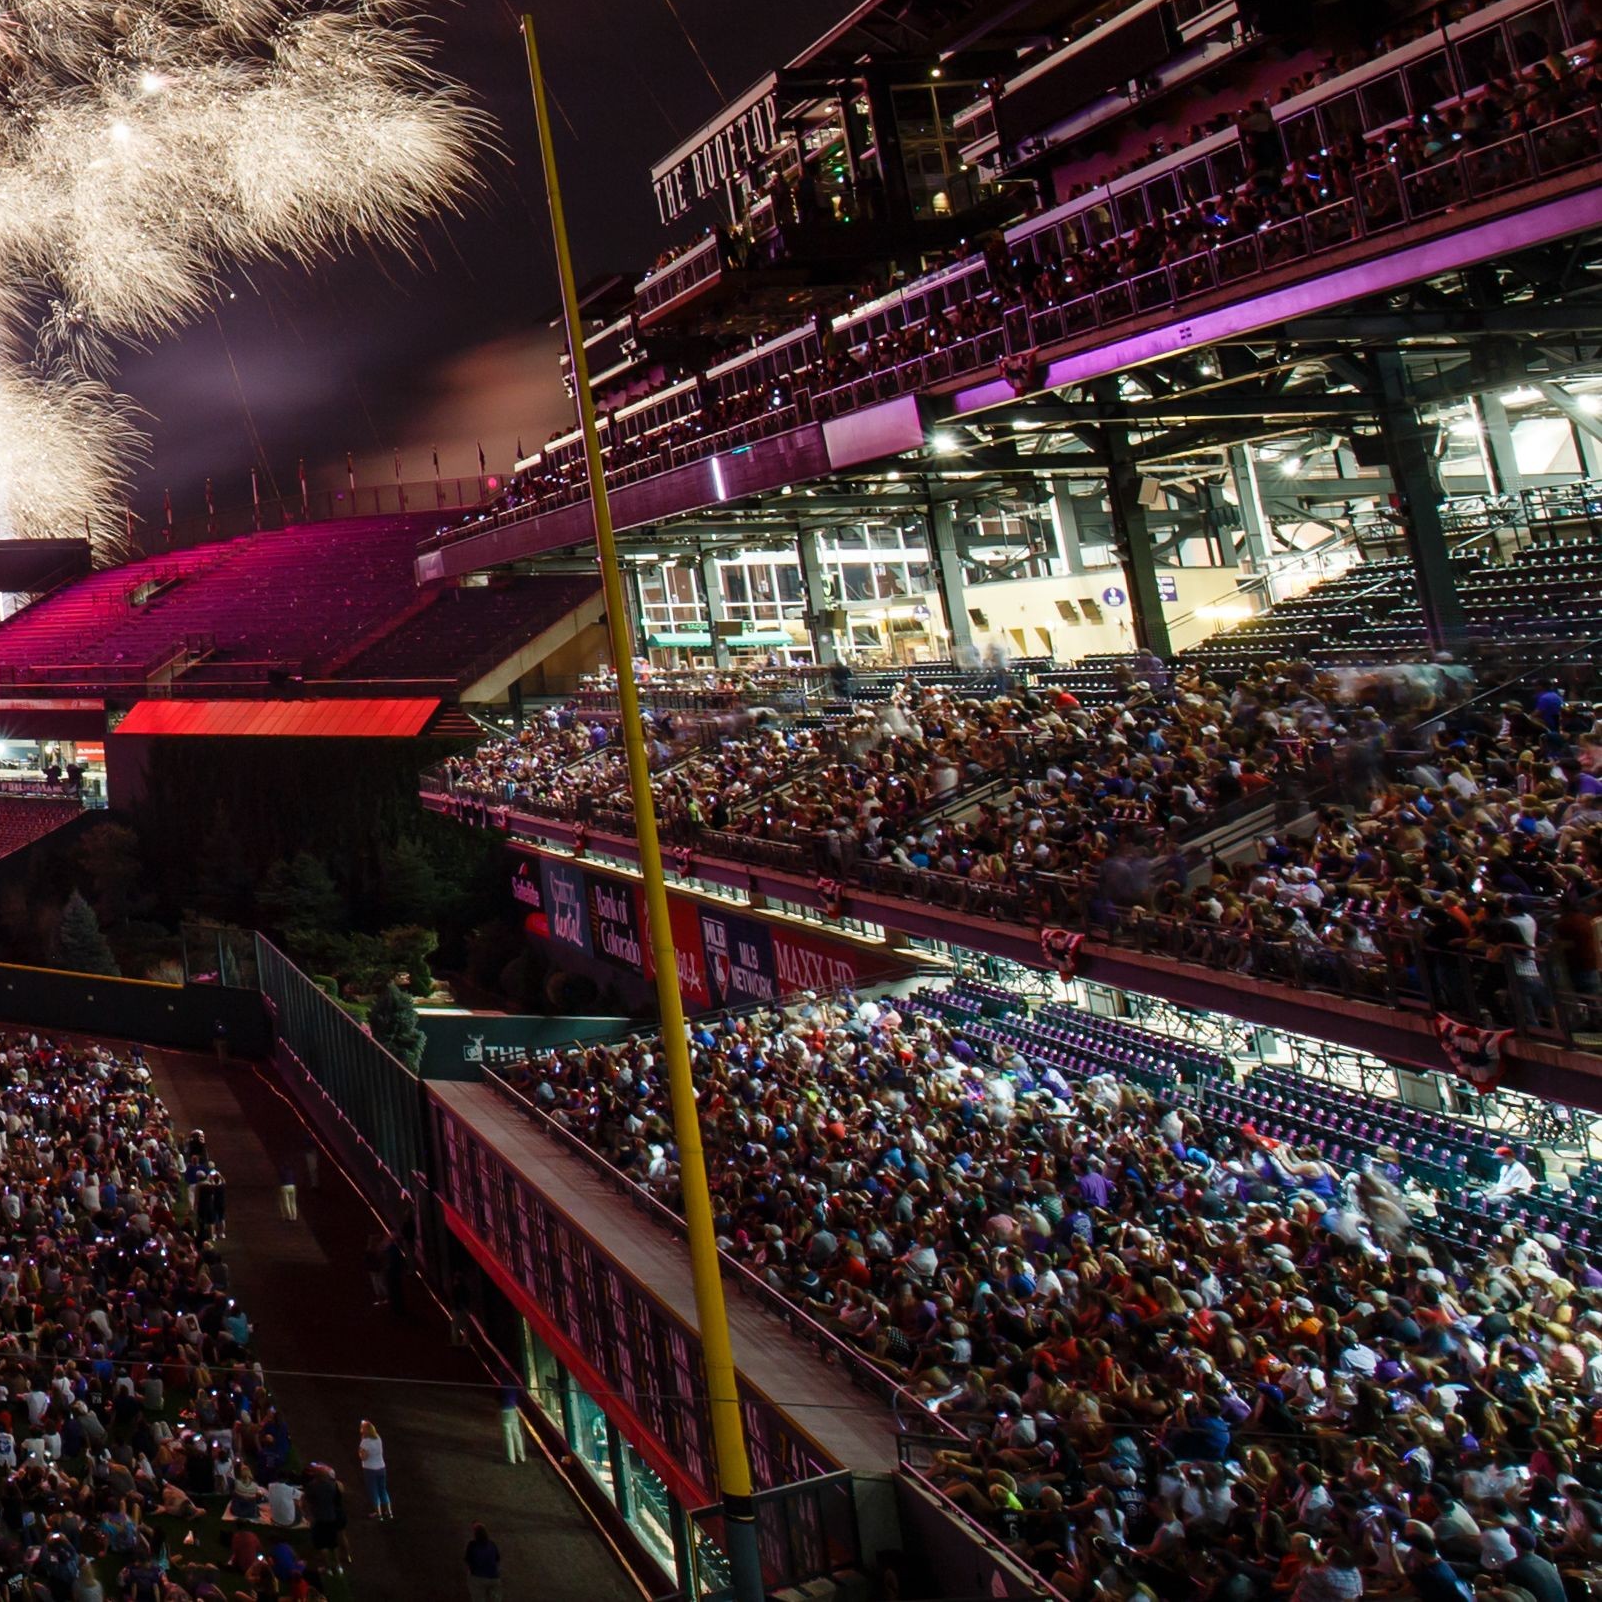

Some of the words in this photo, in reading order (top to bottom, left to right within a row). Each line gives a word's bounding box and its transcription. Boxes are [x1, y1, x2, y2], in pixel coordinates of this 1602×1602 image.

[595, 885, 618, 921] Bank
[601, 922, 641, 966] Colorado
[702, 921, 727, 948] MLB
[738, 942, 759, 970] MLB
[774, 939, 824, 990] MAXX
[826, 956, 856, 991] HD
[731, 965, 774, 999] NETWORK
